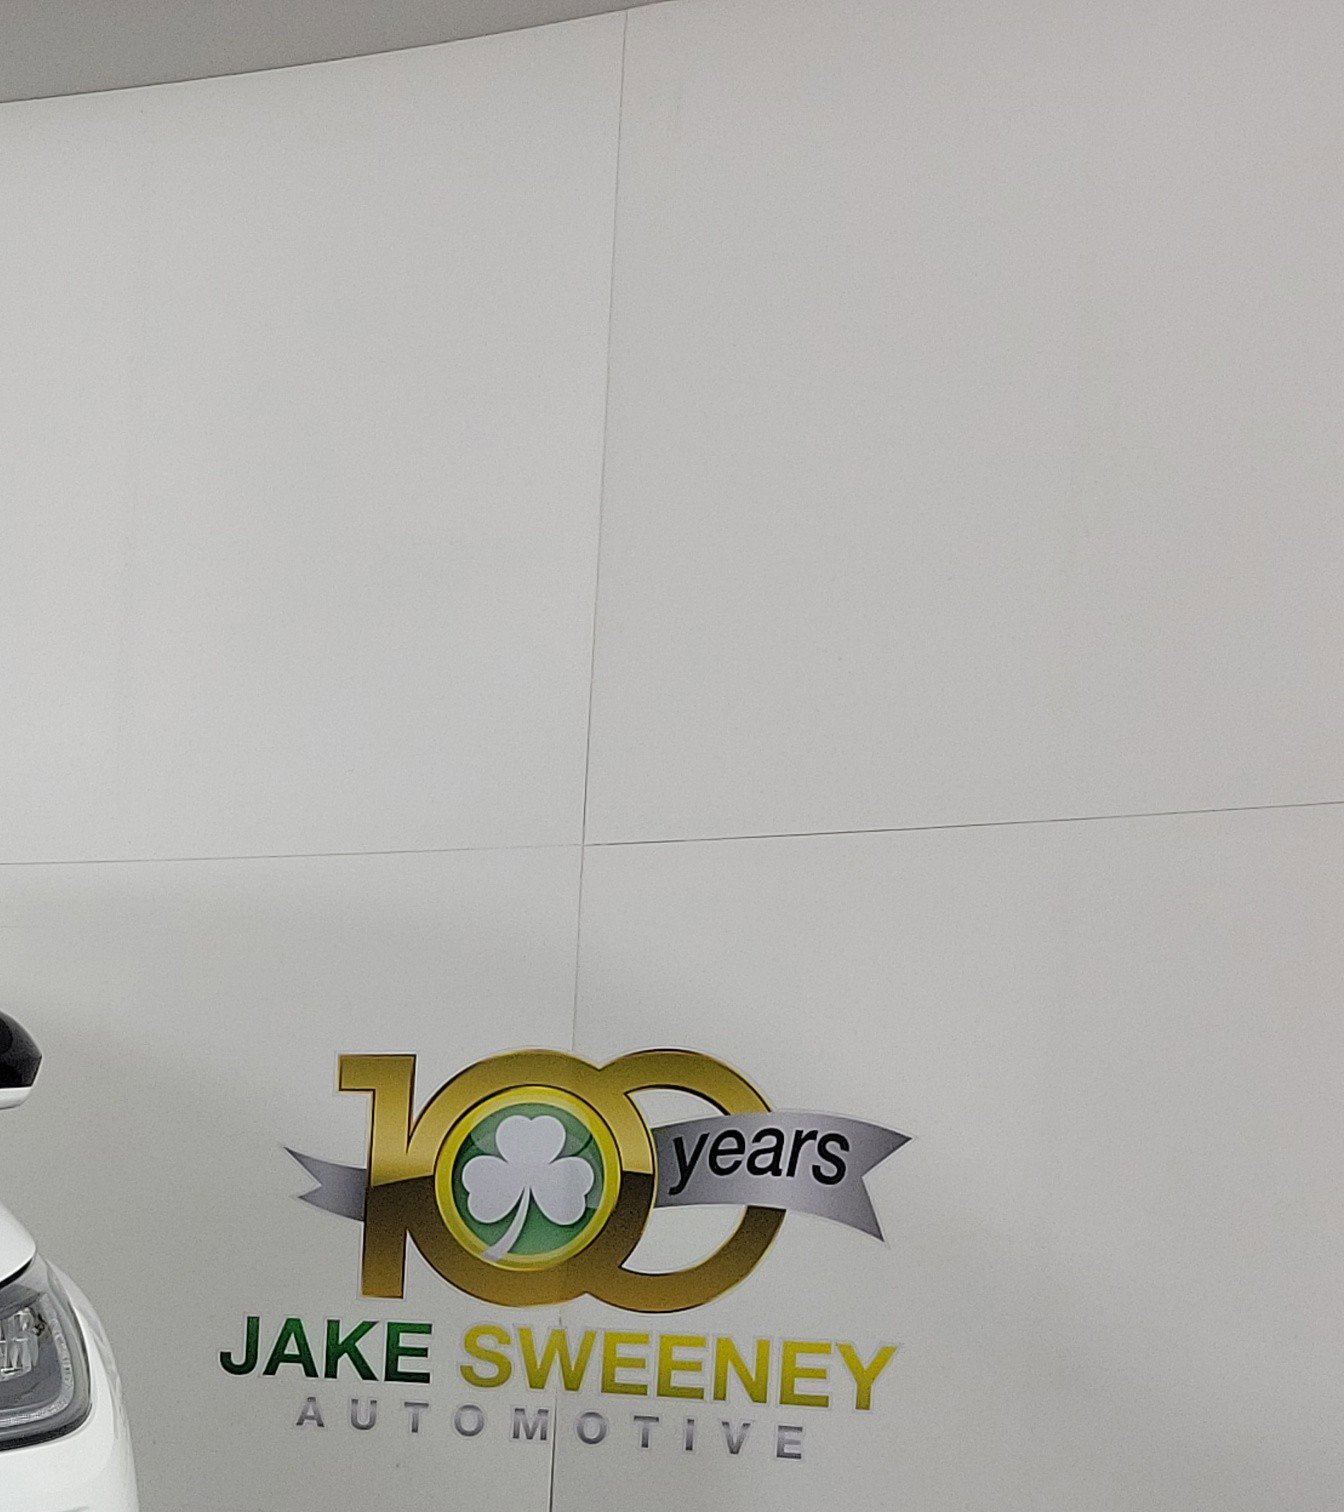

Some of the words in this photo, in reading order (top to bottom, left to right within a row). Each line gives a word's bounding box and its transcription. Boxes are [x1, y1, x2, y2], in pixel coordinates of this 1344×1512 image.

[336, 1049, 787, 1314] 100
[668, 1127, 849, 1195] years
[219, 1315, 432, 1384] JAKE
[458, 1324, 897, 1411] SWEENEY
[296, 1396, 802, 1460] AUTOMOTIVE
